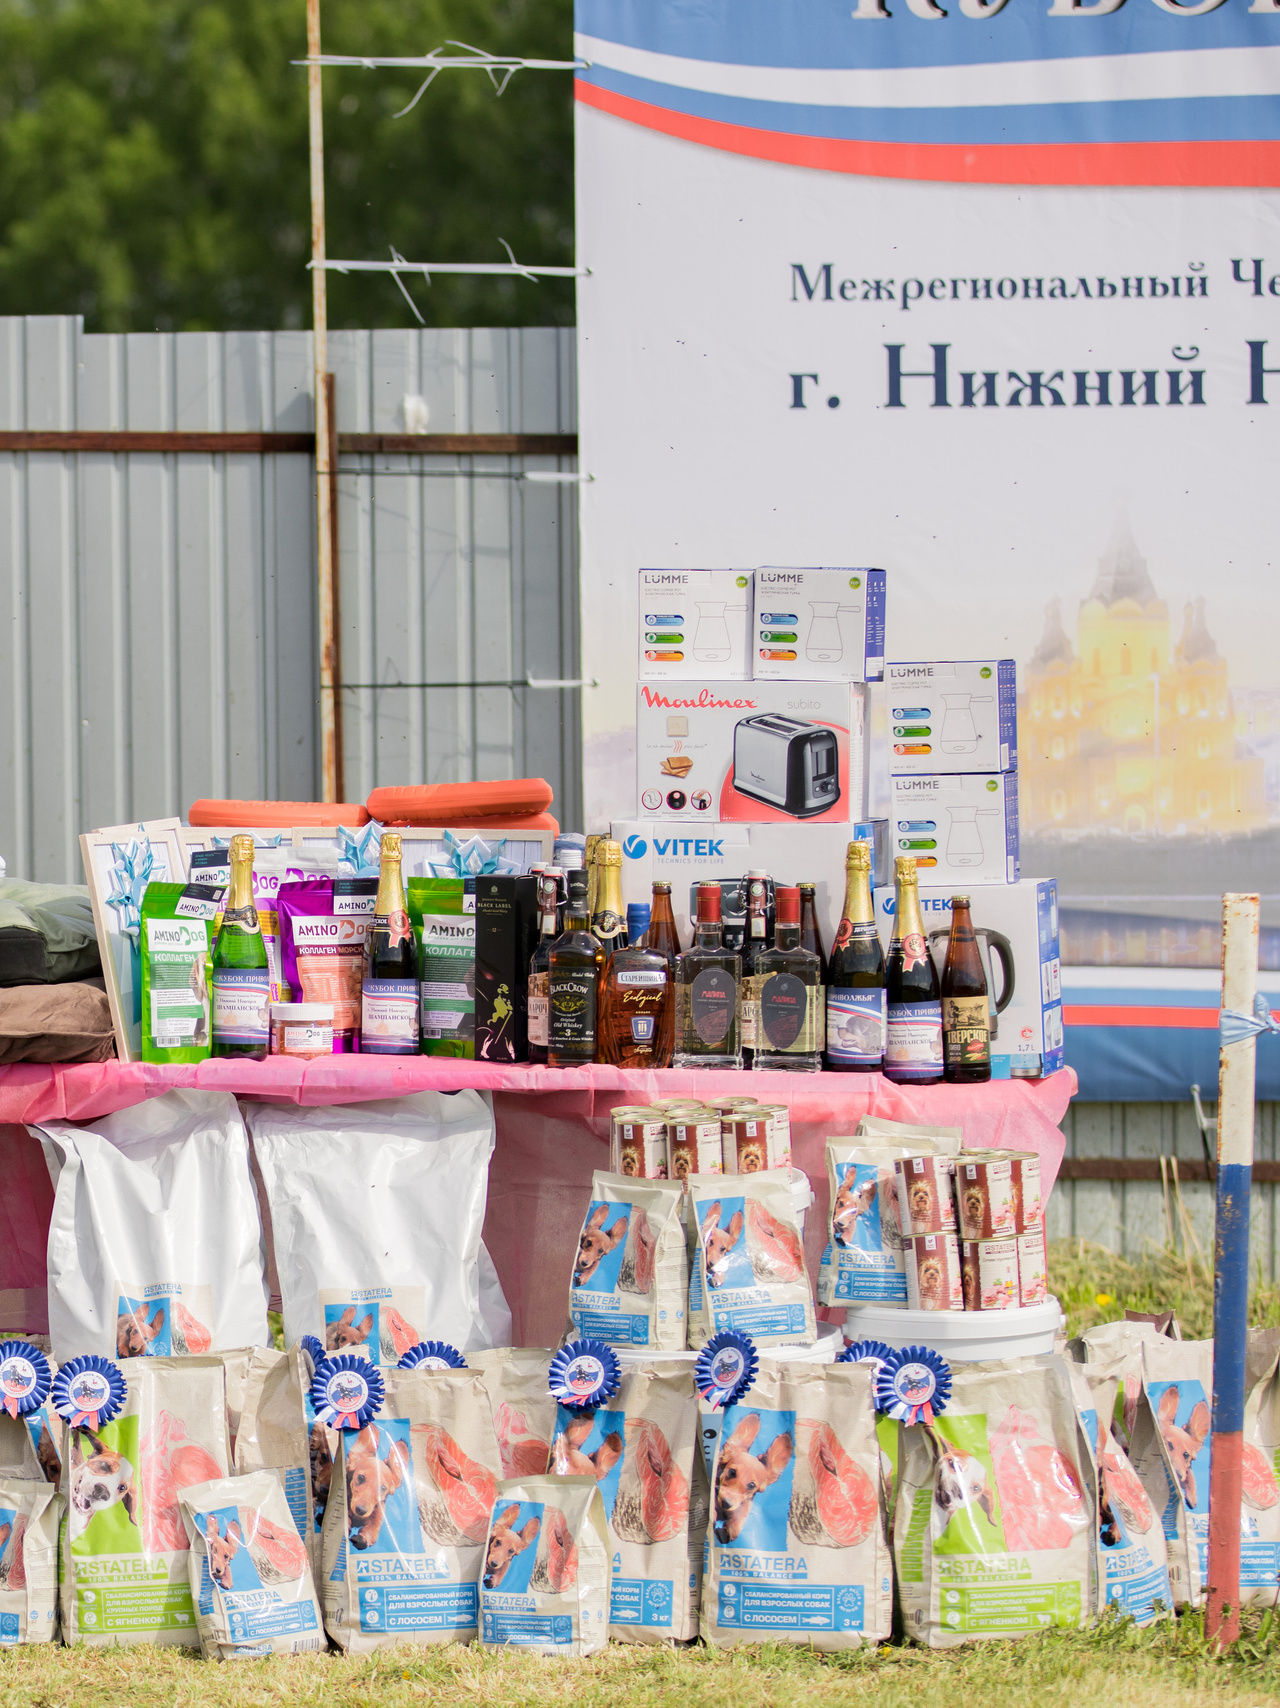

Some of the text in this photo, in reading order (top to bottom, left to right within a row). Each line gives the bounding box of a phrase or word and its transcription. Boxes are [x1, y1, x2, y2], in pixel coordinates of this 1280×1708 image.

[790, 261, 1209, 311] Межрегиональный
[790, 343, 1207, 408] г. Нижний
[641, 685, 758, 709] Moulinex
[787, 699, 821, 710] subito
[653, 839, 724, 856] VITEK
[299, 947, 337, 955] КОЛЛАГЕН
[425, 946, 476, 957] КОЛЛАГЕ
[154, 953, 195, 962] КОЛЛАГЕН
[623, 990, 663, 1007] Ecological
[564, 1028, 572, 1037] 3
[948, 1030, 988, 1043] ТВЕРСКОЕ
[846, 1254, 896, 1265] STATERA
[150, 1283, 183, 1293] STATERA
[357, 1287, 393, 1298] STATERA
[578, 1294, 621, 1305] STATERA
[721, 1290, 771, 1303] STATERA
[88, 1558, 168, 1575] STATERA
[371, 1558, 449, 1573] STATERA
[732, 1554, 808, 1571] STATERA
[953, 1558, 1031, 1574] STATERA
[753, 1571, 794, 1579] BALANCE
[105, 1590, 173, 1599] СБАЛАНСИРОВАННЫЙ
[388, 1592, 455, 1601] СБАЛАНСИРОВАННЫЙ
[744, 1591, 811, 1599] СБАЛАНСИРОВАННЫЙ
[121, 1598, 160, 1606] ВЗРОСЛЫХ
[406, 1600, 448, 1609] ВЗРОСЛЫХ
[449, 1599, 473, 1607] СОБАК
[490, 1596, 537, 1607] STATERA
[744, 1599, 760, 1607] ДЛЯ
[986, 1598, 1023, 1607] ВЗРОСЛЫХ
[107, 1616, 165, 1626] С ЯГНЕНКОМ
[397, 1616, 442, 1625] ЛОСОСЕМ
[651, 1613, 670, 1622] 3 кг
[753, 1615, 797, 1623] ЛОСОСЕМ
[843, 1618, 850, 1626] 3
[970, 1617, 1028, 1627] С ЯГНЕНКОМ
[256, 1626, 283, 1635] ЛОСОСЕМ
